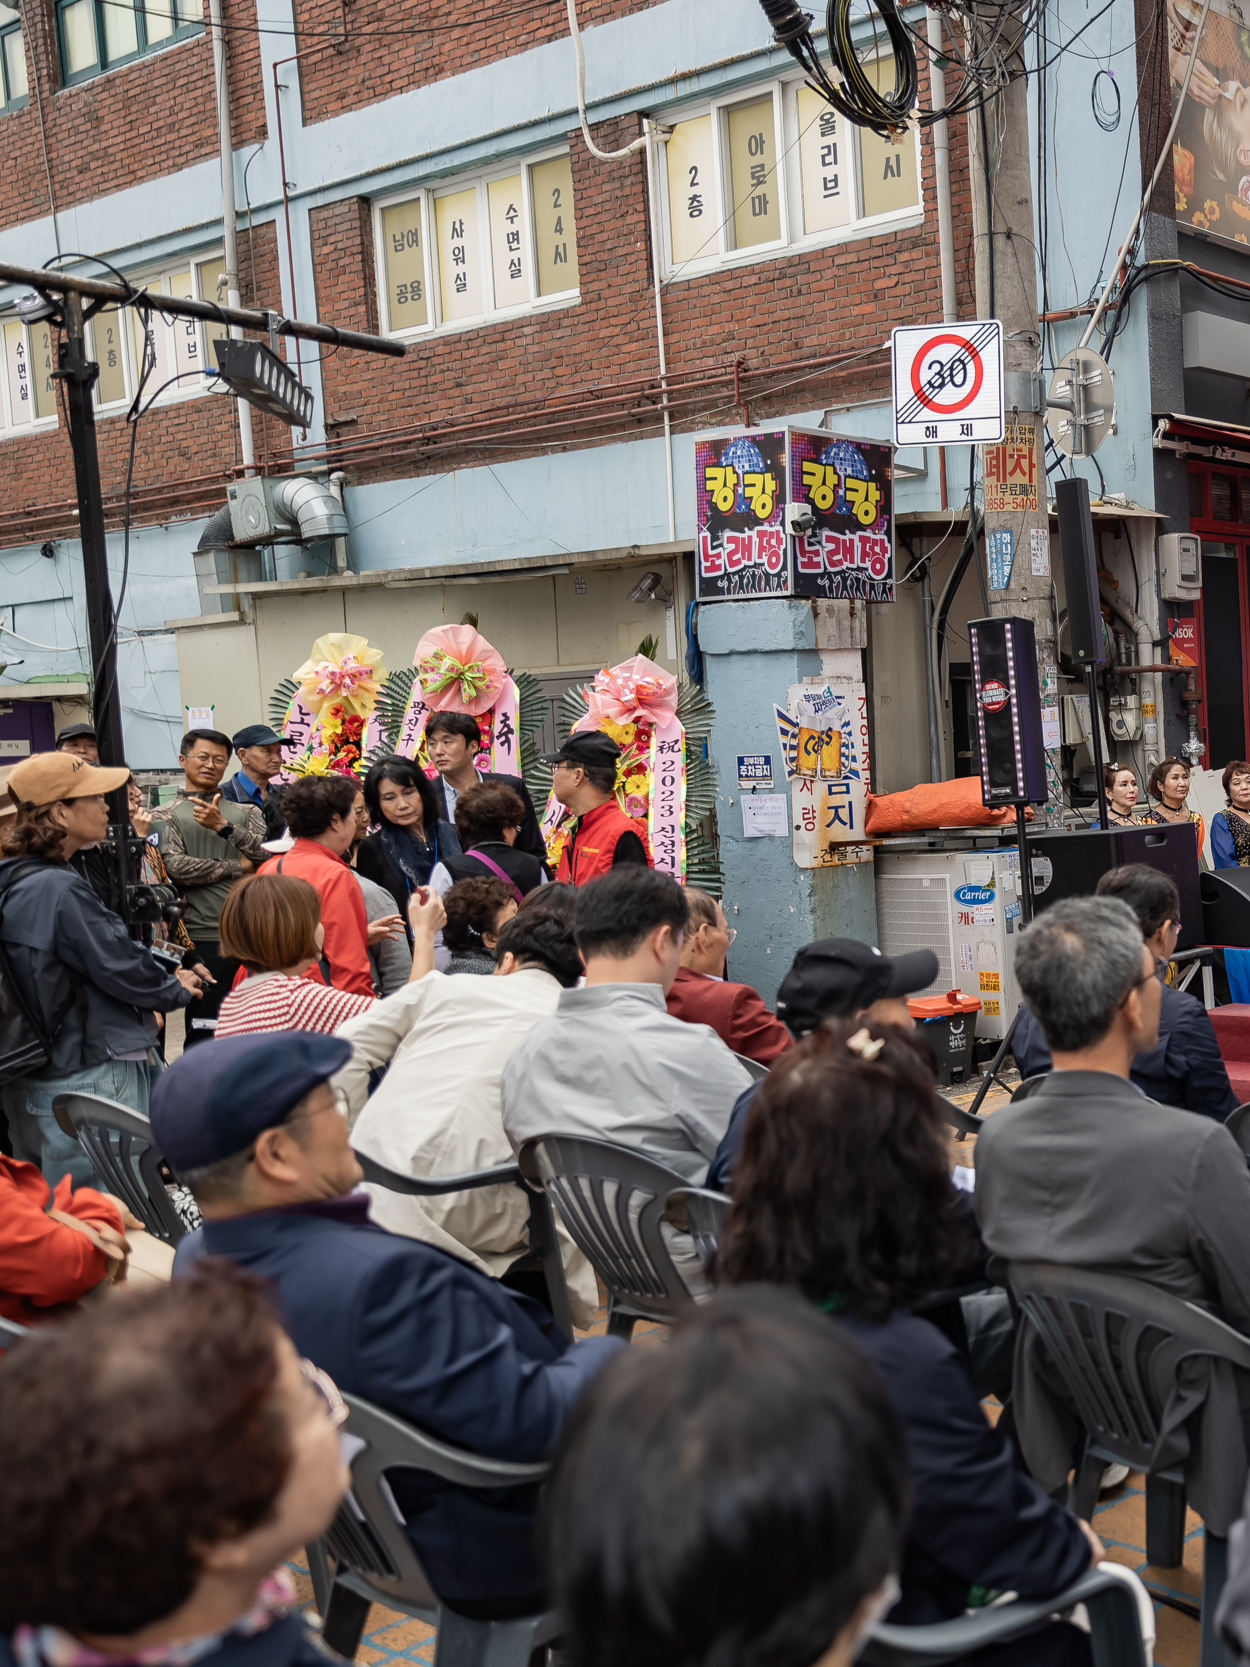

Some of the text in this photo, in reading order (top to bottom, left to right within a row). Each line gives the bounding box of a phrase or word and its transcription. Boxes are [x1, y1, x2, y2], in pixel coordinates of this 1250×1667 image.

[748, 133, 769, 217] 아로마
[819, 111, 839, 199] 올리브
[688, 165, 703, 219] 2층
[393, 228, 419, 253] 남여
[505, 204, 522, 279] 수면실
[552, 187, 567, 265] 24시
[451, 219, 467, 293] 샤워실
[396, 280, 422, 305] 공용
[16, 342, 28, 401] 수면실
[106, 327, 117, 368] 2층
[927, 359, 967, 389] 30
[984, 446, 1037, 484] 폐차
[704, 465, 777, 521] 캉캉
[802, 460, 885, 527] 캉캉
[401, 700, 429, 748] 광진구
[496, 712, 514, 757] 축
[739, 765, 771, 777] 주차금지
[743, 757, 765, 765] 외부차량
[659, 759, 676, 818] 2023
[959, 888, 992, 901] Carrier
